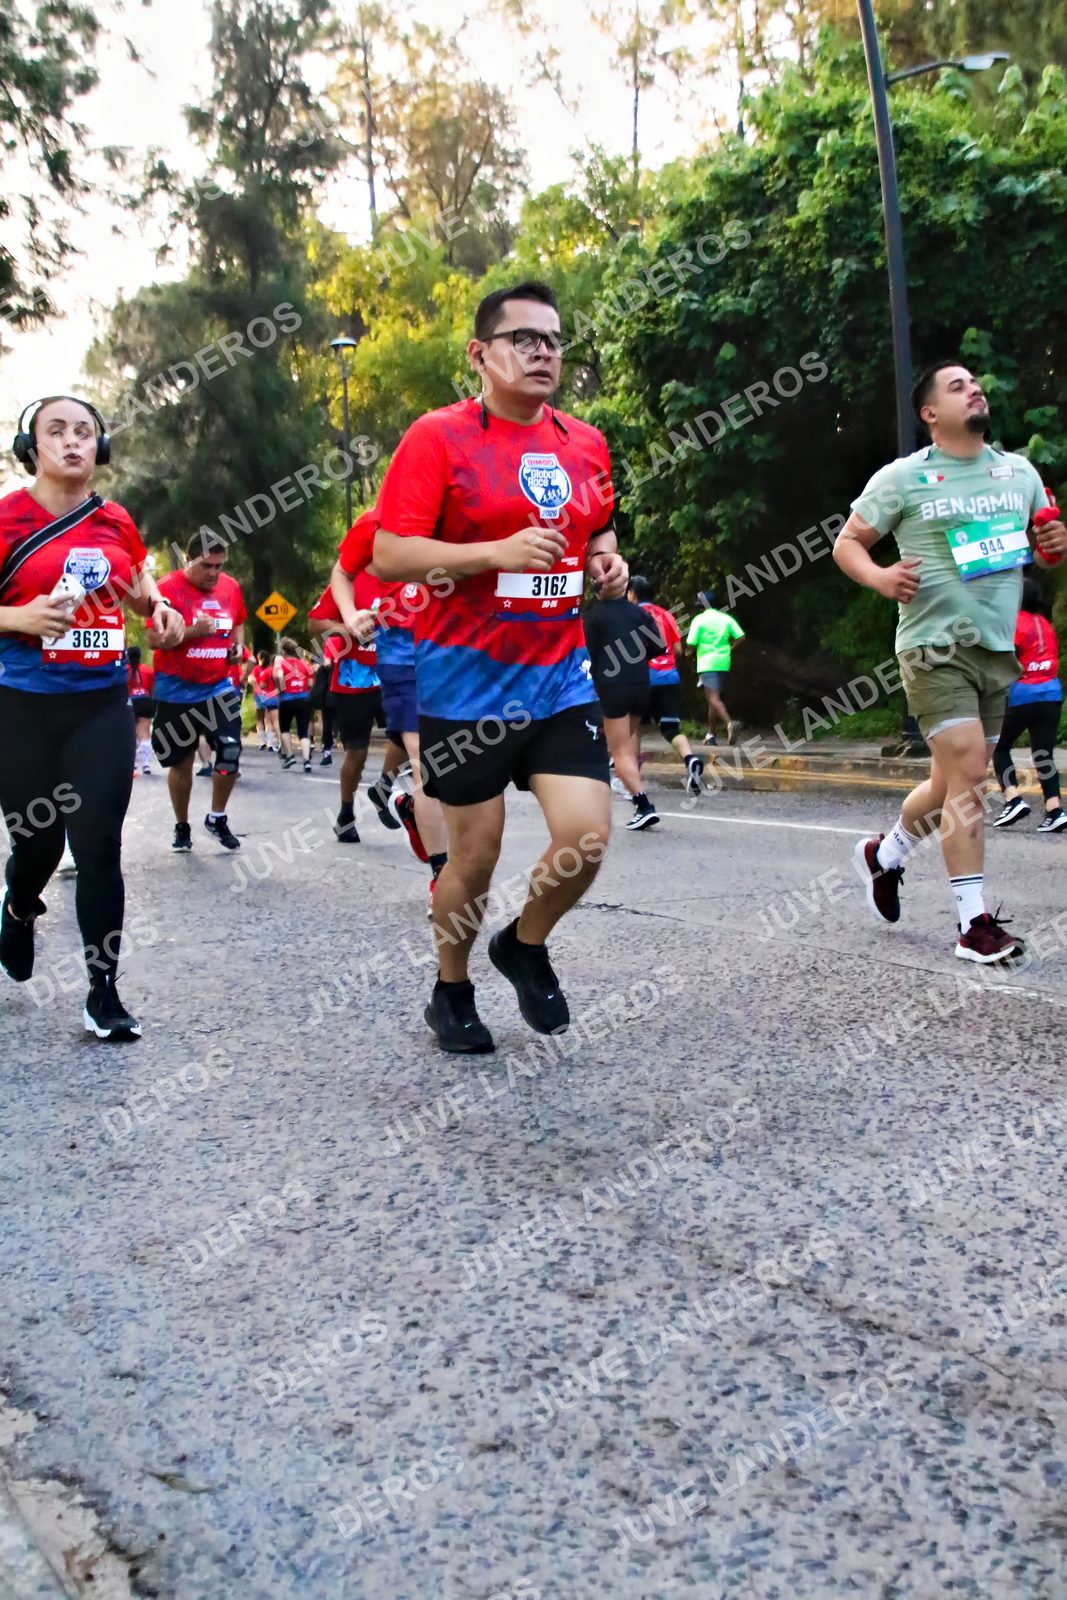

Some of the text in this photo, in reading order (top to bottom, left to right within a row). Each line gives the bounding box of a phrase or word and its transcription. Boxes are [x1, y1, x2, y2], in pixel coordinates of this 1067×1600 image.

[979, 538, 1005, 556] 944
[531, 575, 568, 597] 3162
[72, 630, 109, 649] 3623
